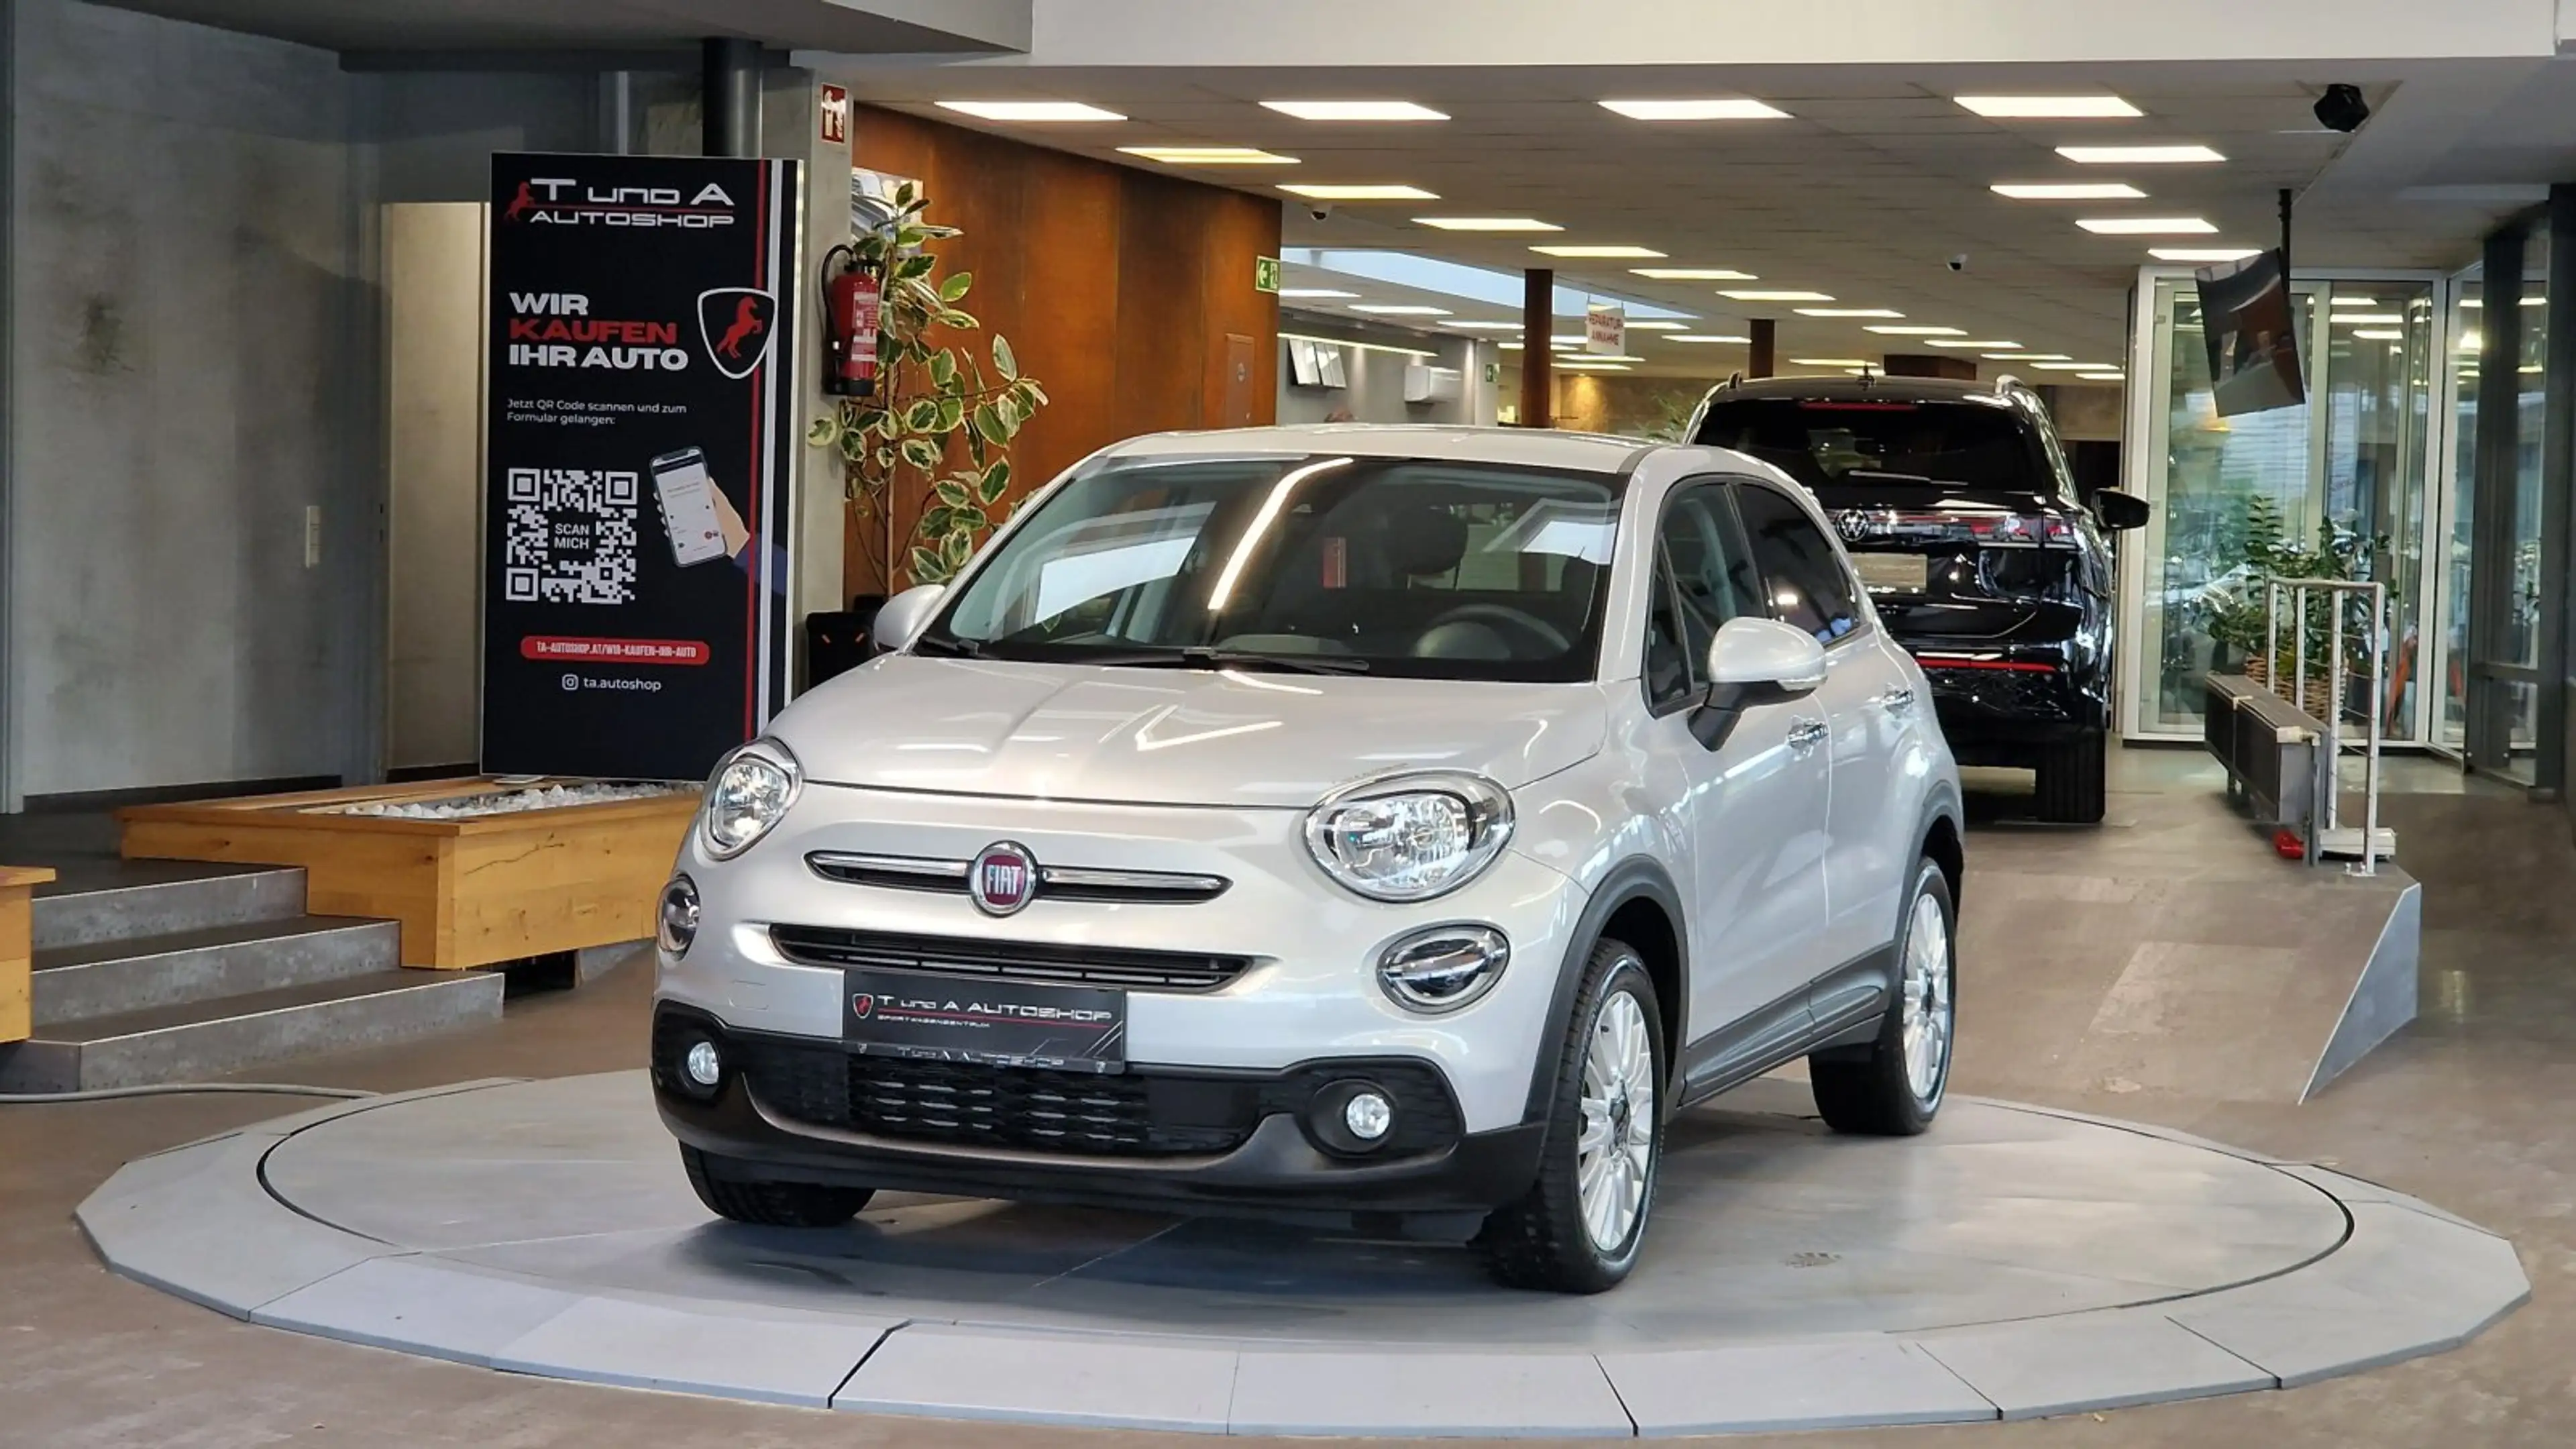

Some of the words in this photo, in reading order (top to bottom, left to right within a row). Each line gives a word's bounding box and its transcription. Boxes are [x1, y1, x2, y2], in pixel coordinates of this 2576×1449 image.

[531, 178, 577, 201] T
[690, 182, 735, 207] A
[529, 210, 735, 228] AUTOSHOP
[508, 292, 590, 316] WIR
[508, 319, 678, 345] KAUFEN
[508, 344, 576, 368] IHR
[580, 347, 690, 371] AUTO
[507, 398, 535, 409] Jetzt
[537, 399, 554, 410] QR
[556, 399, 586, 411] Code
[587, 402, 635, 413] scannen
[637, 402, 659, 413] und
[661, 405, 687, 414] zum
[506, 411, 557, 423] Formular
[559, 413, 616, 427] gelangen:
[554, 523, 590, 536] SCAN
[553, 537, 590, 550] MICH
[583, 676, 662, 692] ta.autoshop
[984, 863, 1022, 896] FIAT
[877, 994, 896, 1006] T
[943, 1000, 961, 1012] A
[967, 1002, 1112, 1022] AUTOSHOP
